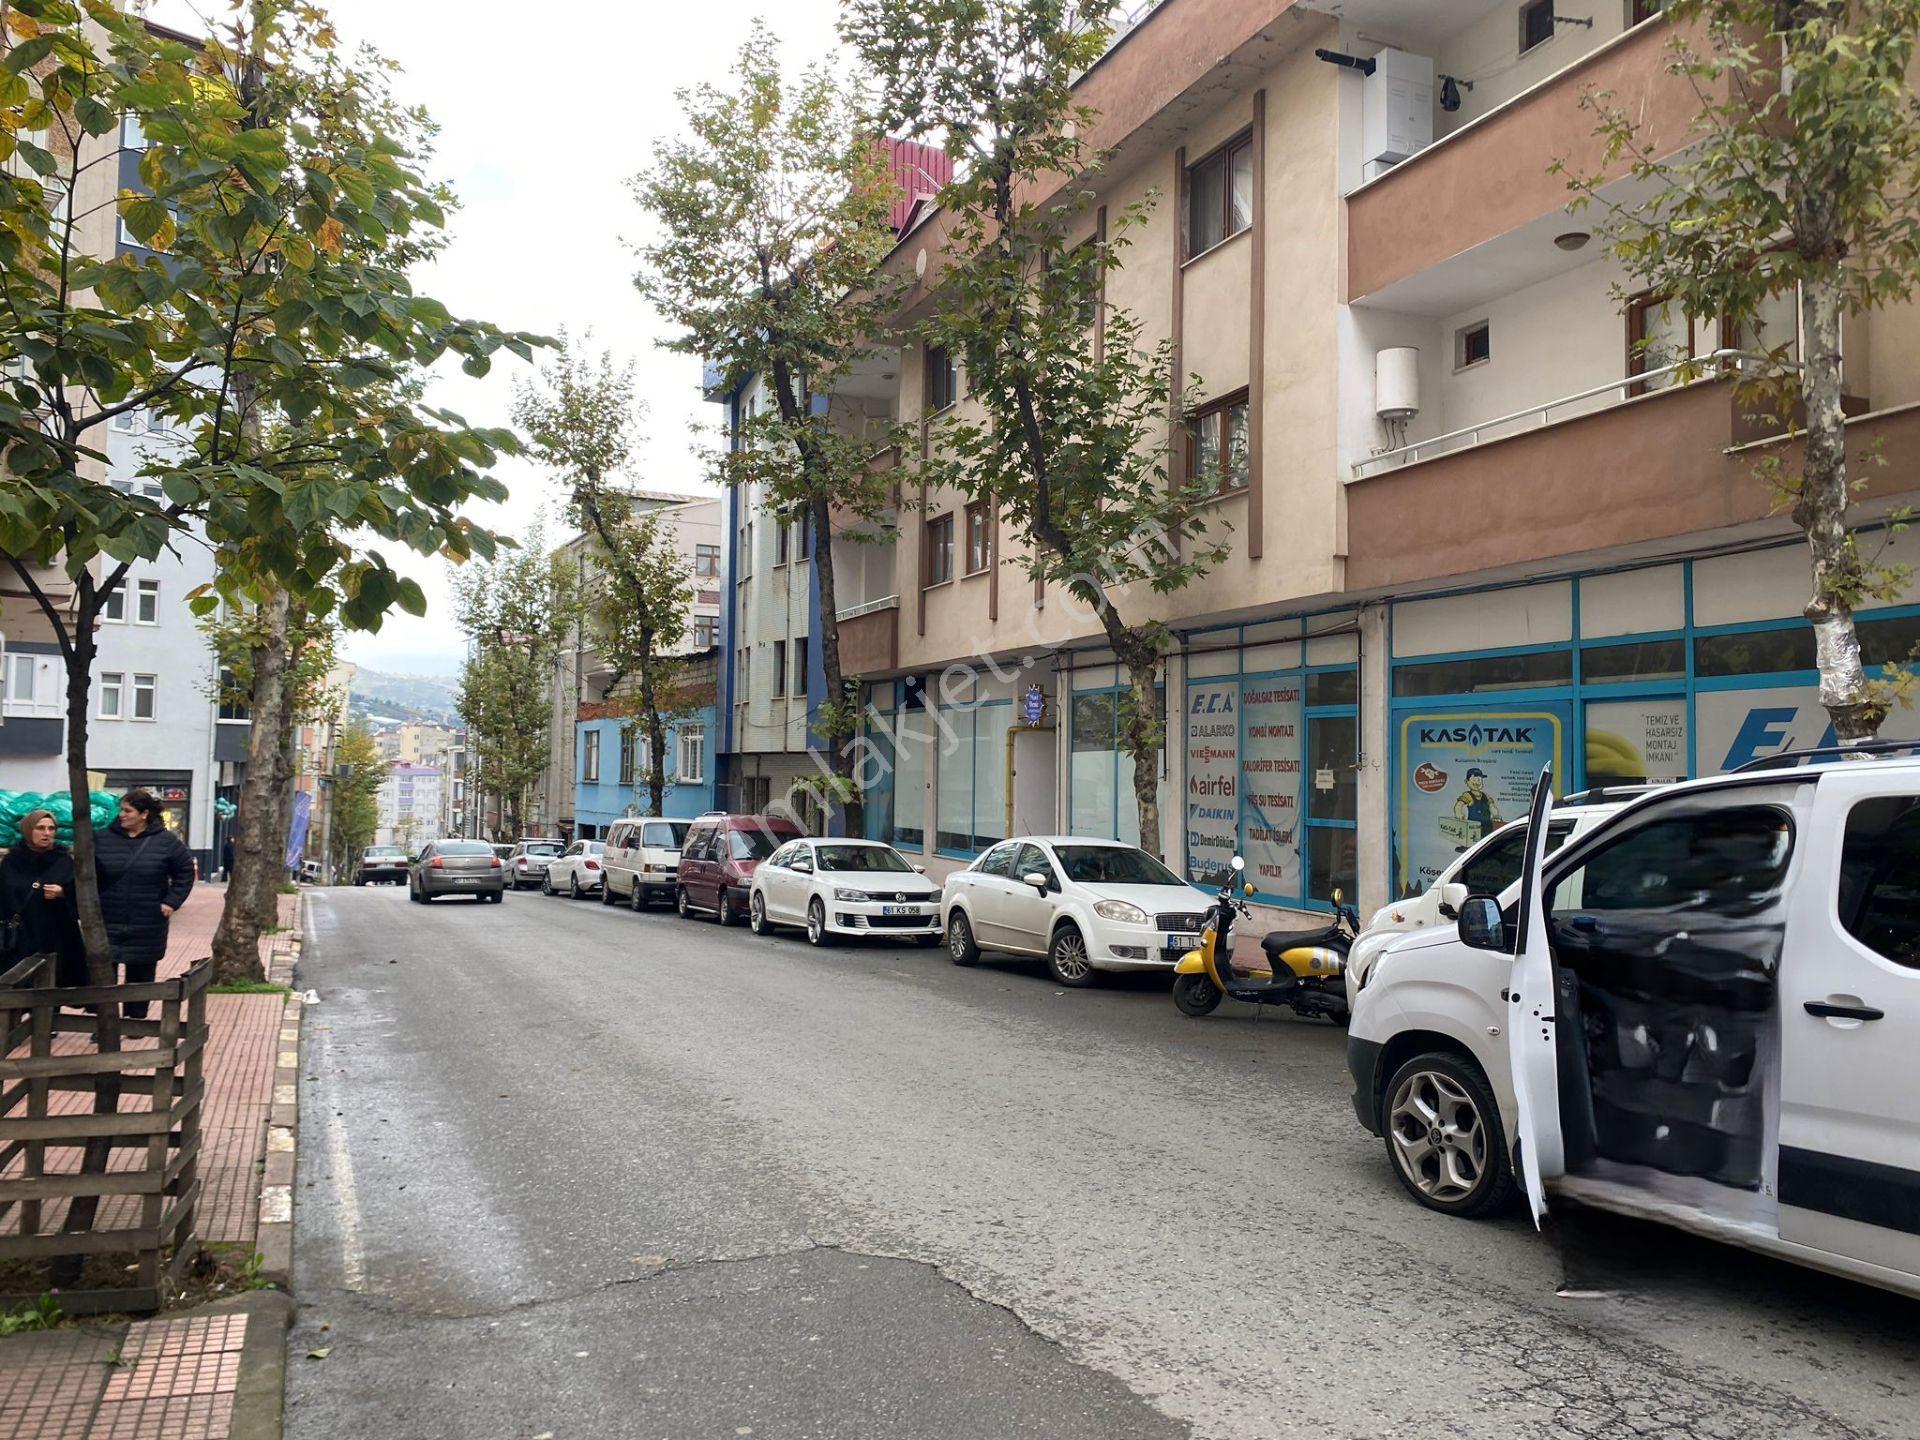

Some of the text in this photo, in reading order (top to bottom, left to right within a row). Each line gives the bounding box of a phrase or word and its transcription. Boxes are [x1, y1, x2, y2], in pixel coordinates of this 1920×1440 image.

[1670, 714, 1680, 725] VE
[1199, 724, 1235, 738] ALARKO
[1248, 723, 1294, 738] KOMBİ MONTAJI
[1646, 727, 1683, 738] HASARSIZ
[1646, 740, 1677, 750] MONTAJ
[1199, 773, 1236, 797] airfel
[1258, 794, 1267, 807] SU
[1199, 807, 1235, 820] DAIKIN
[1189, 855, 1234, 873] Buderus
[1420, 865, 1446, 877] Köse
